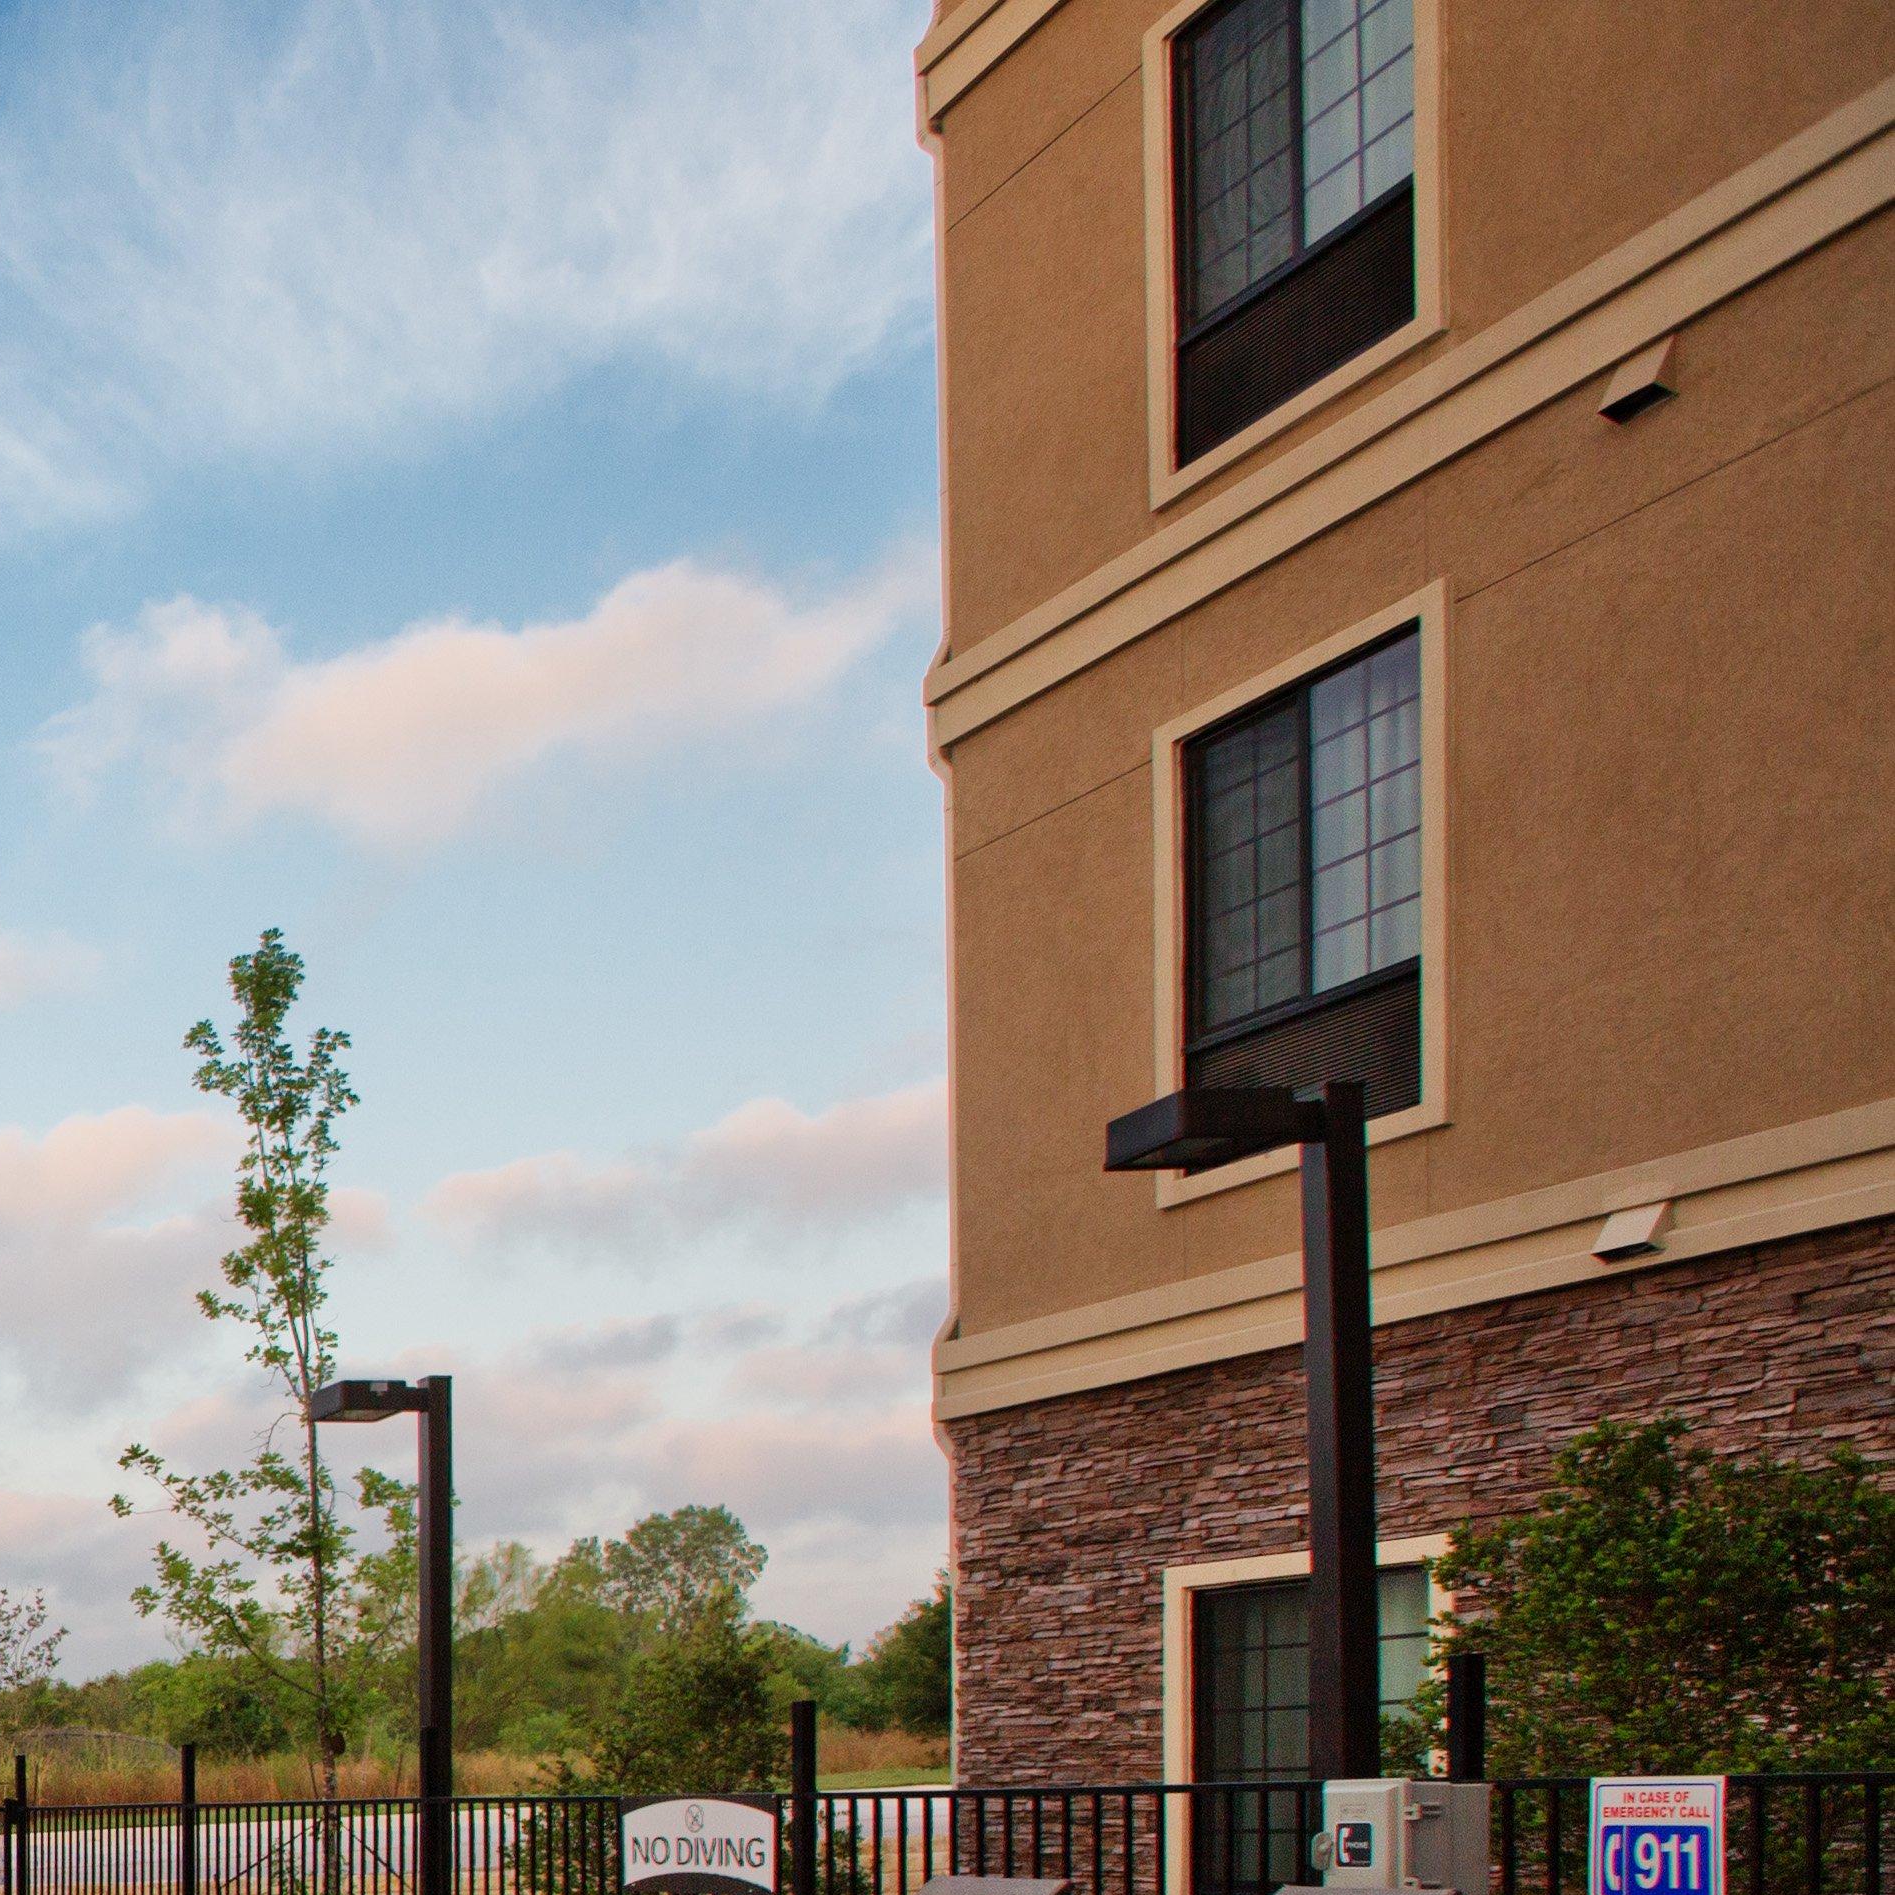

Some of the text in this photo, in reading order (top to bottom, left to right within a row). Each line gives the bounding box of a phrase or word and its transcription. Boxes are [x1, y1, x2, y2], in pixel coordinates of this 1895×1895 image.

[1623, 1791, 1690, 1803] IN CASE OF
[1603, 1807, 1710, 1818] EMERGENCY CALL
[1345, 1841, 1369, 1850] PHONE
[632, 1836, 765, 1868] NO DIVING
[1633, 1832, 1702, 1889] 911
